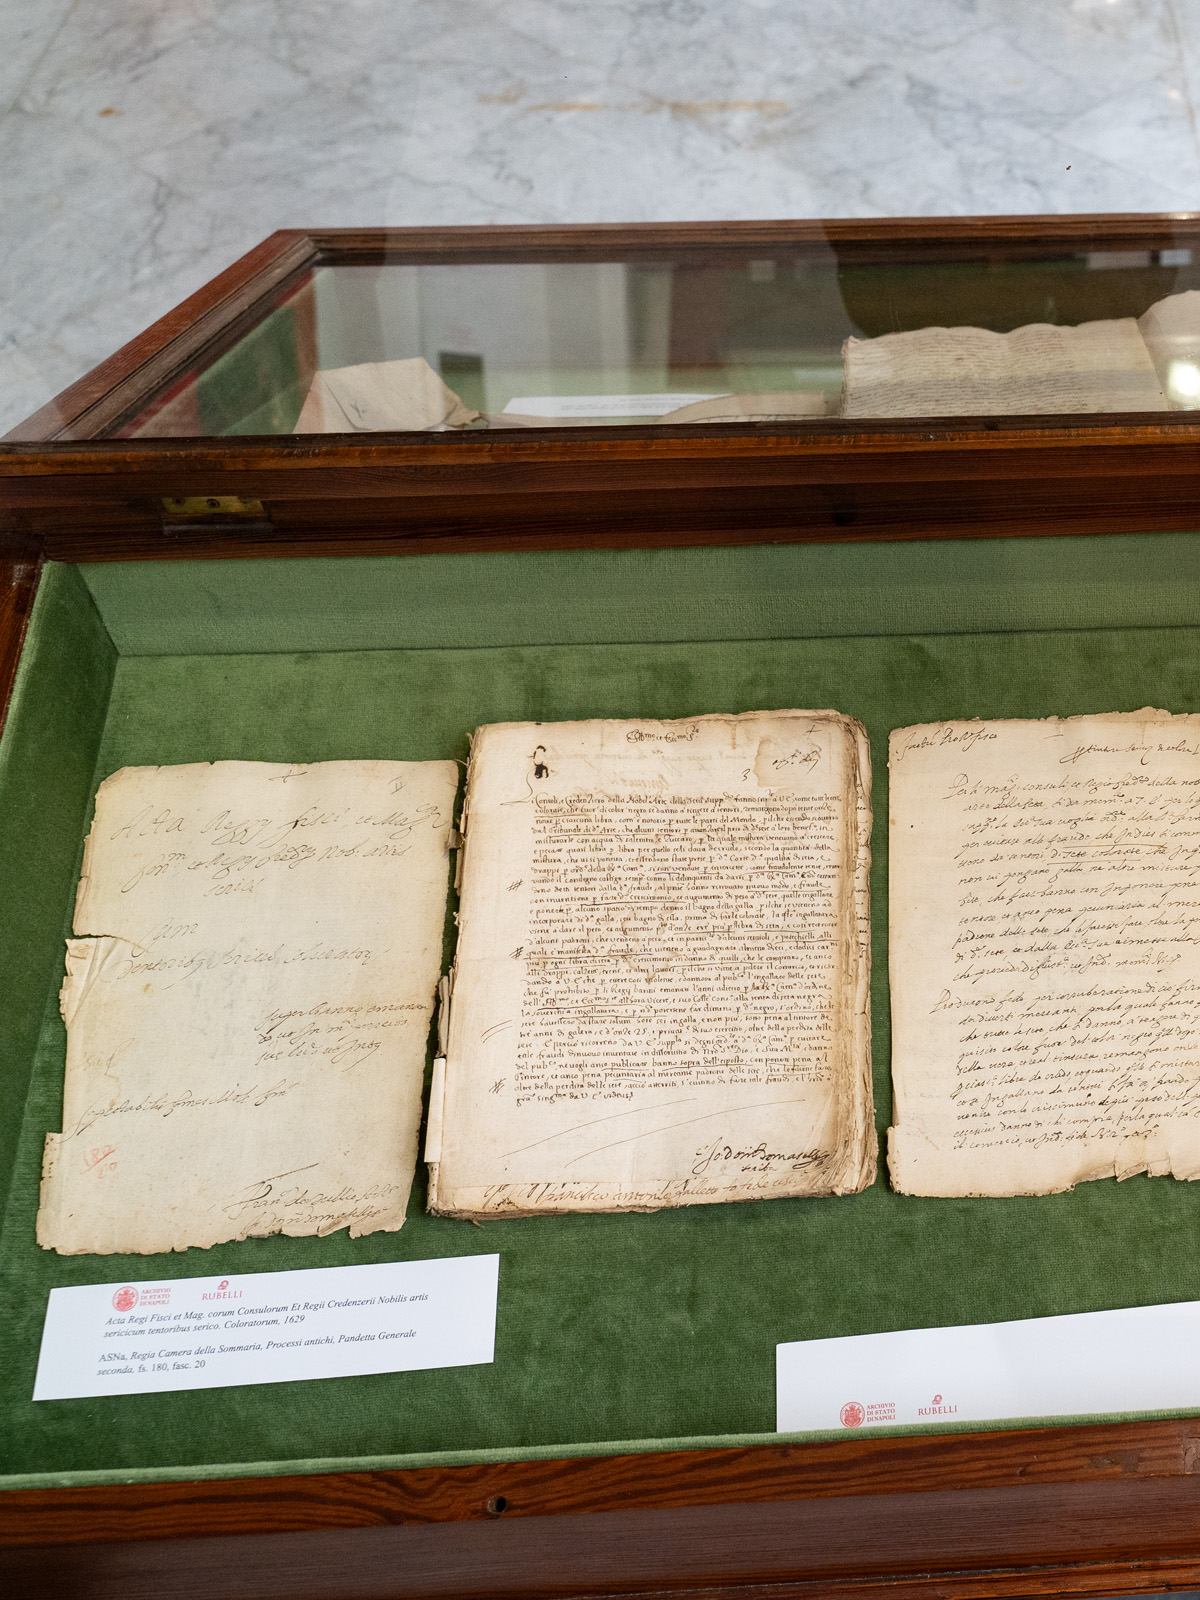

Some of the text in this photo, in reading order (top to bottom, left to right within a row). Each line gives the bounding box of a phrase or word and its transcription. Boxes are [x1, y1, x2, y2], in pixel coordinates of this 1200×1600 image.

[202, 1290, 243, 1300] RUBELLI
[105, 1317, 126, 1326] Acta
[128, 1315, 148, 1325] Regi
[150, 1313, 172, 1322] Fisci
[184, 1311, 204, 1321] Mag.
[237, 1304, 288, 1315] Consulorum
[291, 1303, 300, 1311] Et
[303, 1301, 325, 1312] Regii
[327, 1297, 376, 1308] Credenzerii
[378, 1295, 407, 1304] Nobilis
[409, 1293, 429, 1301] artis
[104, 1315, 305, 1338] sericicum tentoribus serico. Coloratorum, 1629
[98, 1329, 417, 1362] ASNa, Regia Camera della Sommaria, Processi antichi, Pandetta Generale
[97, 1360, 206, 1376] seconda, fs. 180, fasc. 20
[918, 1405, 957, 1416] RUBELLI
